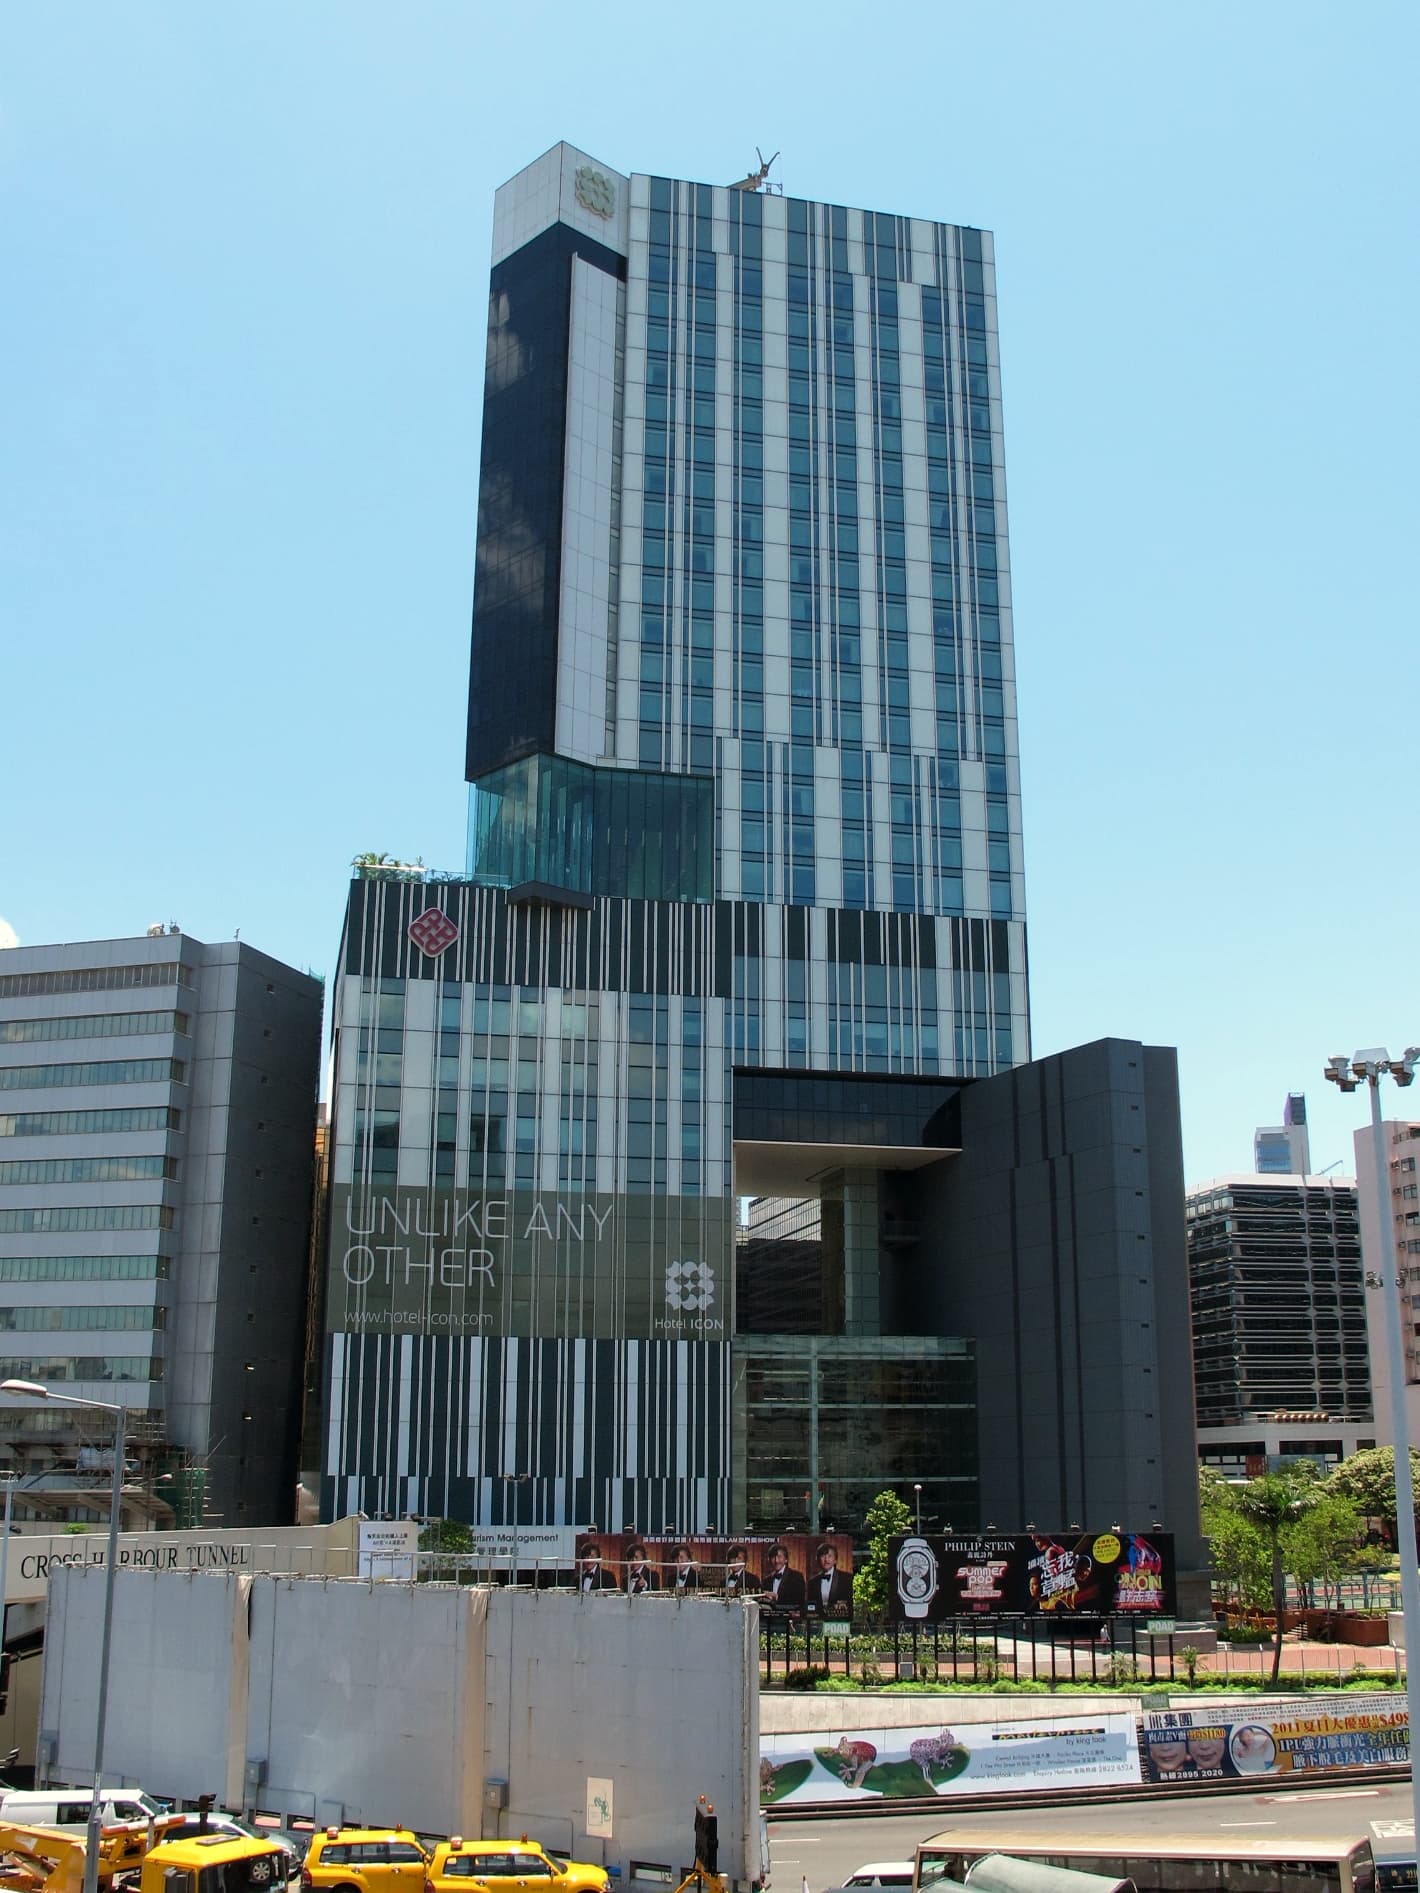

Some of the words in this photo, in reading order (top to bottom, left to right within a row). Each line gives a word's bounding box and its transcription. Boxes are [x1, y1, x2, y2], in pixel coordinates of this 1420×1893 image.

[346, 1195, 509, 1239] UNLIKE
[523, 1203, 613, 1241] ANY
[343, 1245, 495, 1288] OTHER
[344, 1308, 493, 1326] www.hotel-icon.com
[655, 1317, 687, 1330] Hotel
[691, 1318, 724, 1330] ICON
[497, 1534, 558, 1544] Maagement
[944, 1542, 981, 1552] PHILIP
[984, 1541, 1016, 1551] STEIN
[92, 1547, 177, 1569] HRBOUR
[187, 1545, 248, 1567] TUNNEL
